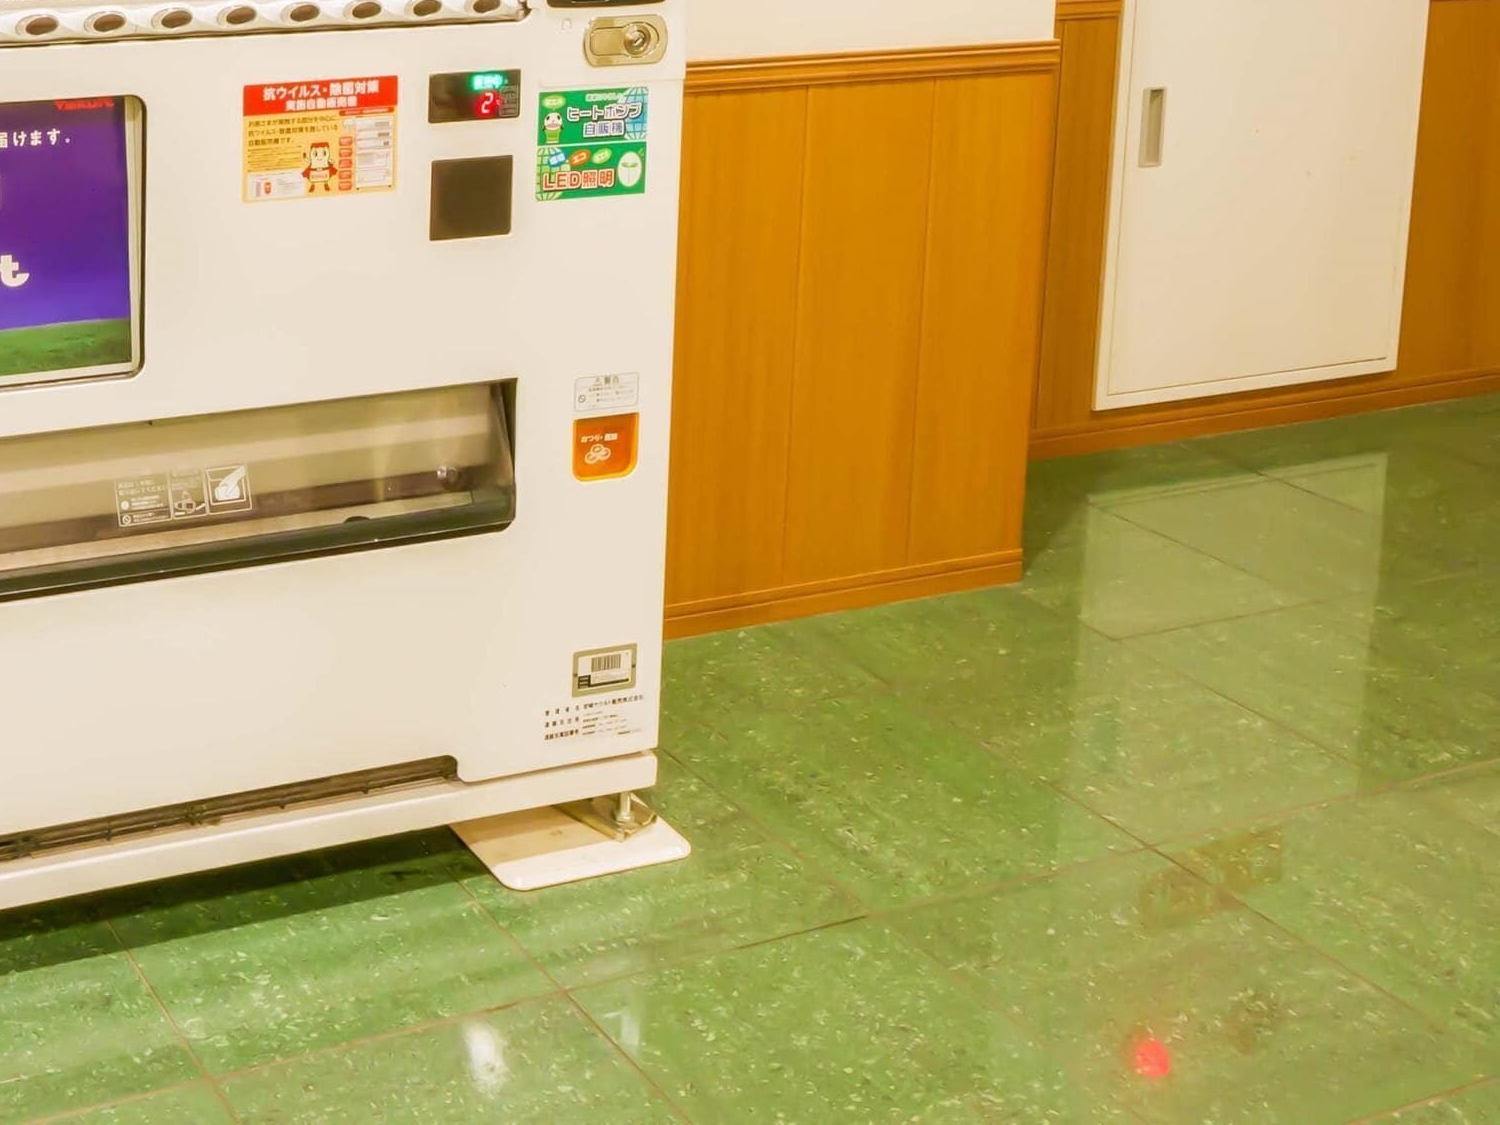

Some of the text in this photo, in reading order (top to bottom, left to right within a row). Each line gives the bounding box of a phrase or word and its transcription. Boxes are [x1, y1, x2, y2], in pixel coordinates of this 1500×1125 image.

[481, 91, 492, 114] 2
[583, 120, 625, 138] 自販機
[543, 168, 615, 191] LED照明
